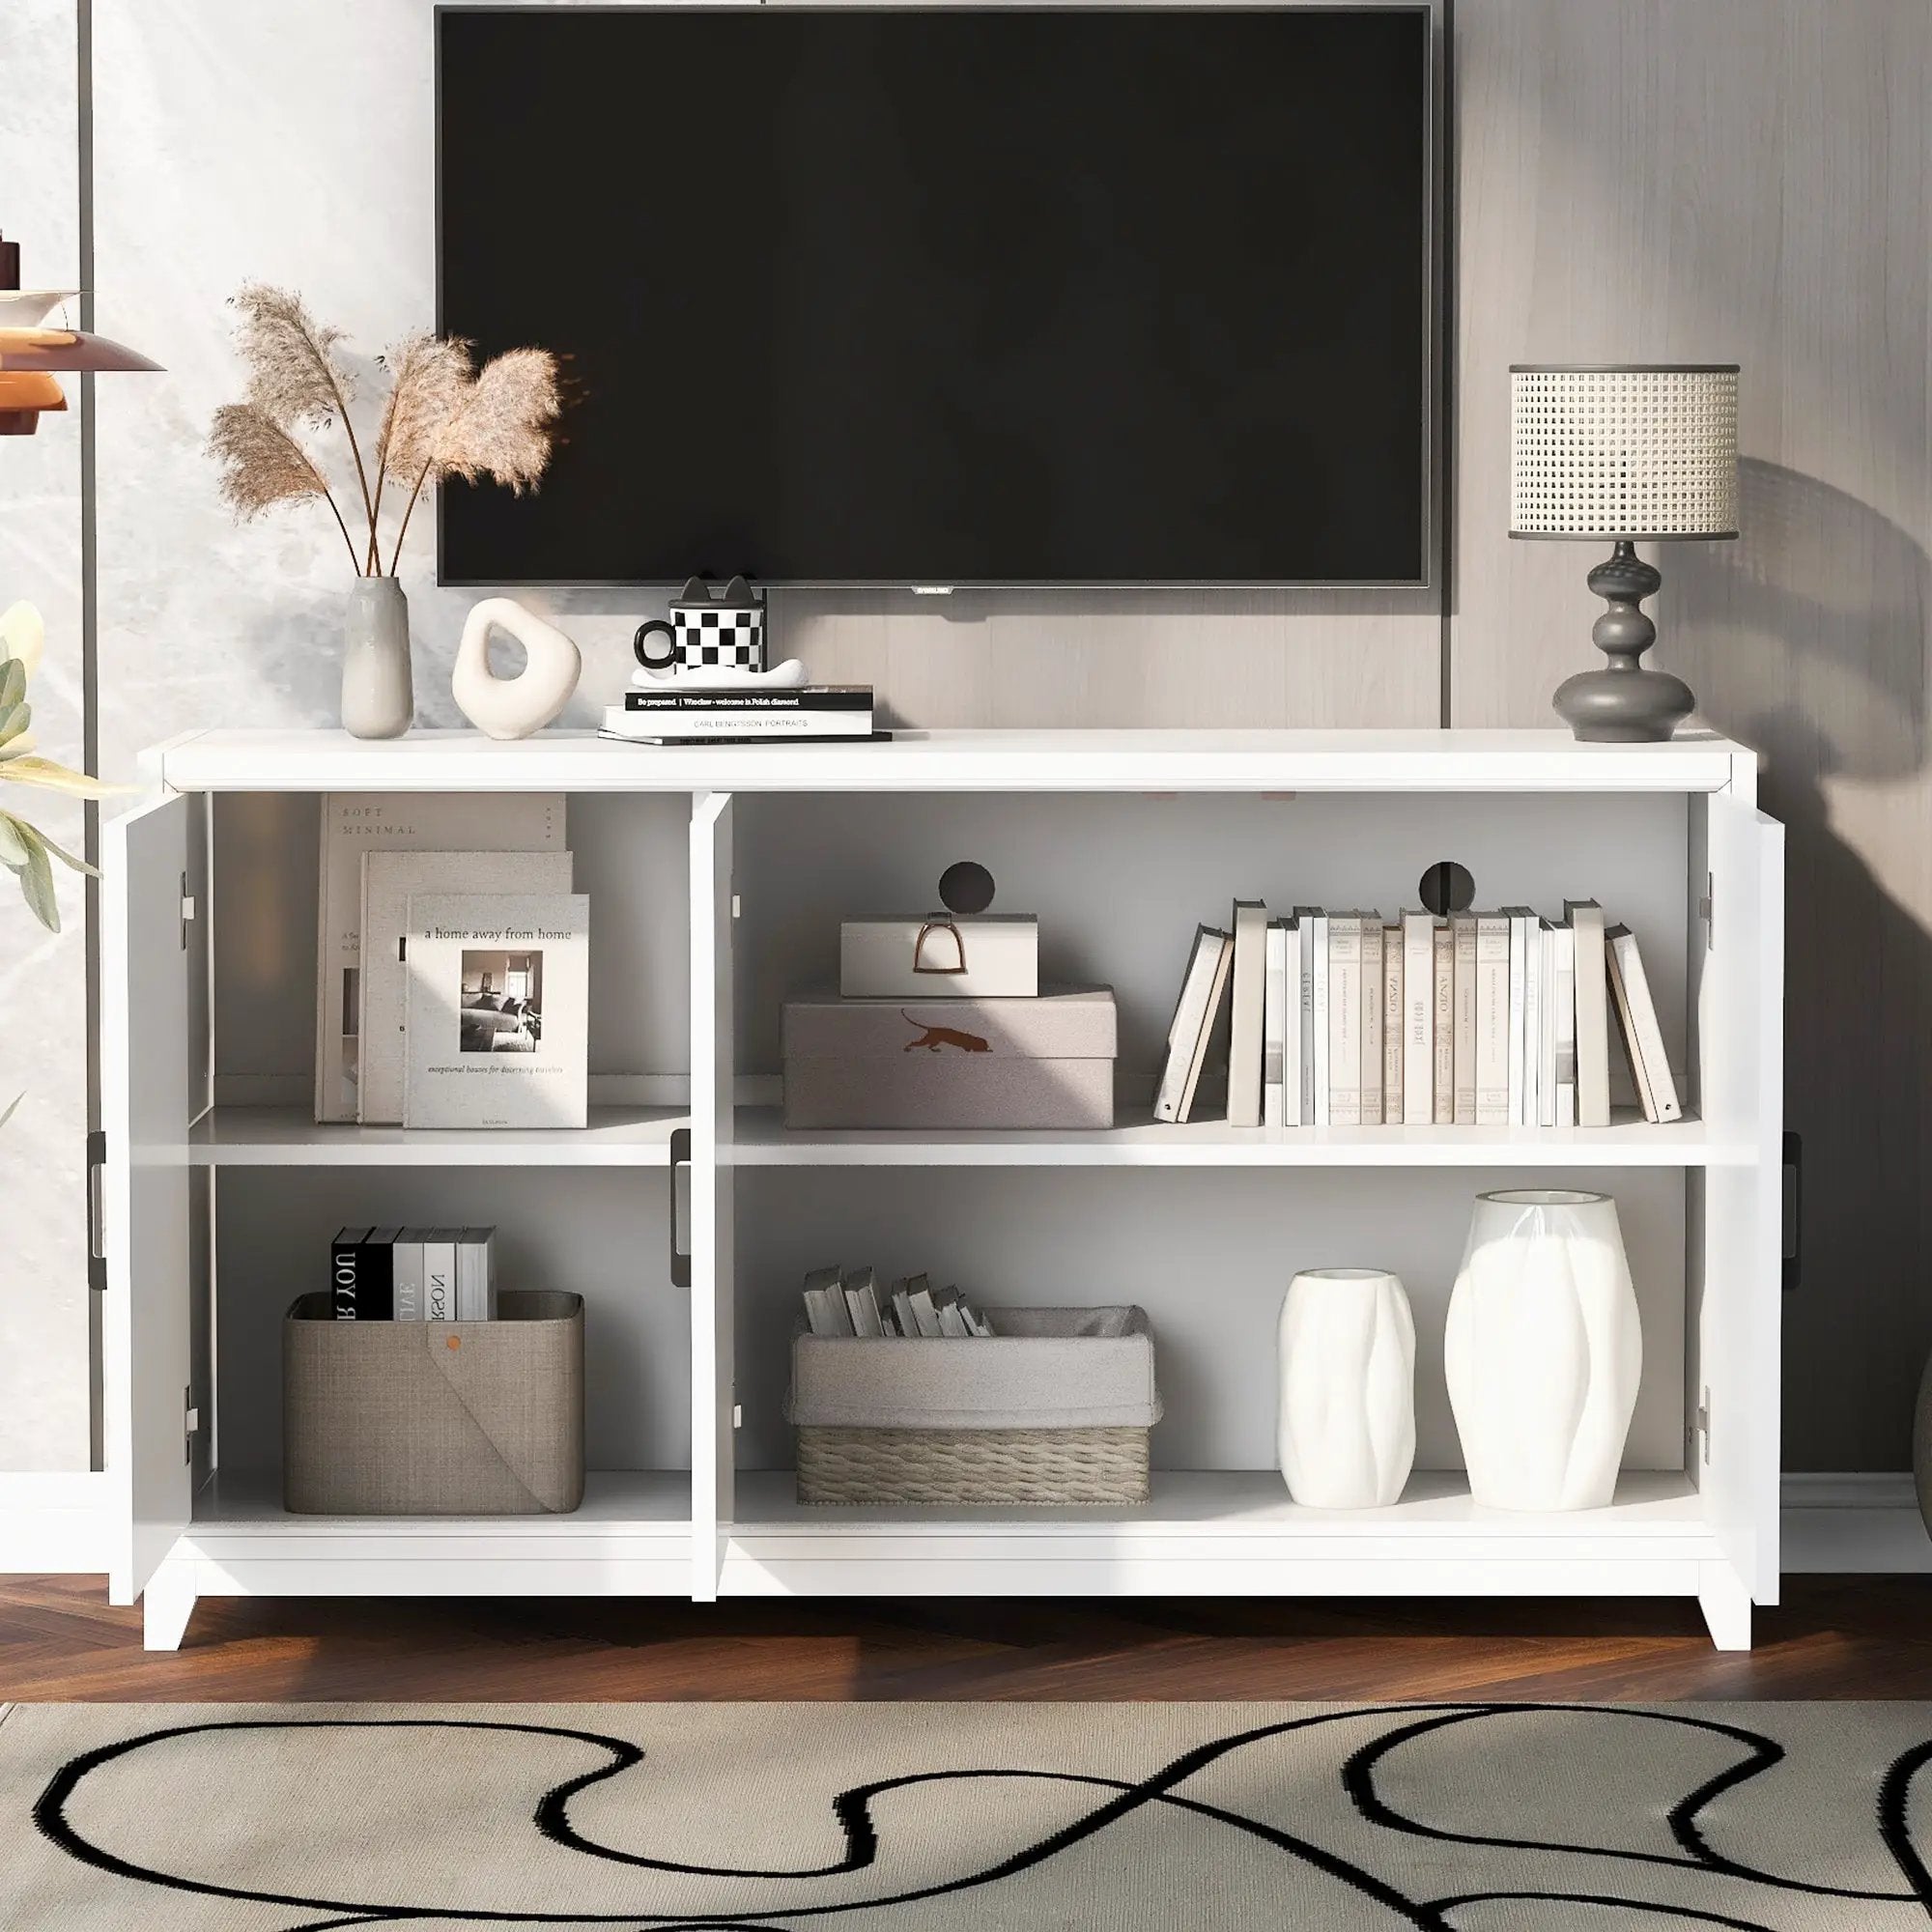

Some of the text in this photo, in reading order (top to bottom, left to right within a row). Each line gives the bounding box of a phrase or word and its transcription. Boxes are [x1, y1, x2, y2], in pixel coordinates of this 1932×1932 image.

[694, 720, 714, 728] CARL
[764, 719, 809, 727] PORTRAITS
[342, 808, 382, 817] SOFT
[424, 926, 572, 942] a home away from home
